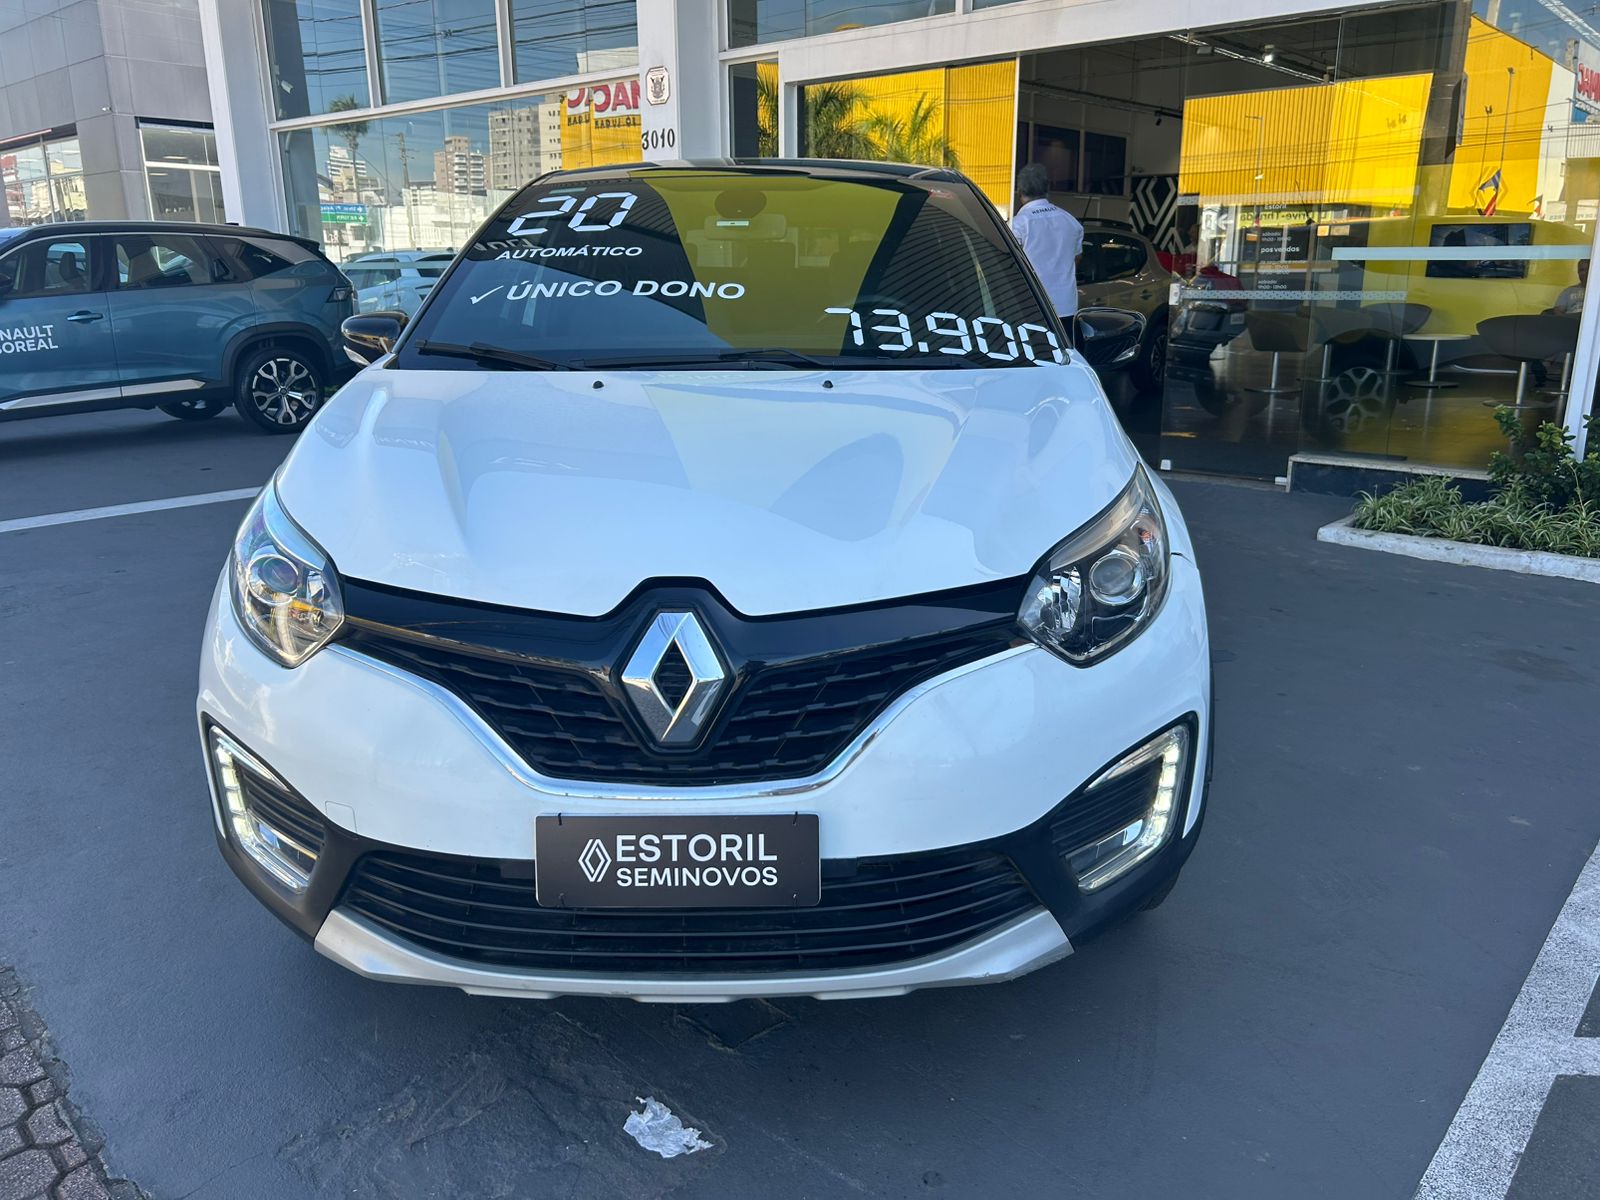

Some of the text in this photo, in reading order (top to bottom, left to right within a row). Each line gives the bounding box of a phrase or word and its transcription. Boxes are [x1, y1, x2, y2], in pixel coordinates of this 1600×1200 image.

[641, 128, 676, 150] 3010
[506, 192, 638, 236] 20
[494, 245, 643, 260] AUTOMÁTICO
[506, 280, 745, 300] ÚNICO DONO
[824, 308, 1069, 367] 73.900
[616, 833, 778, 862] ESTORIL
[616, 866, 778, 887] SEMINOVOS
